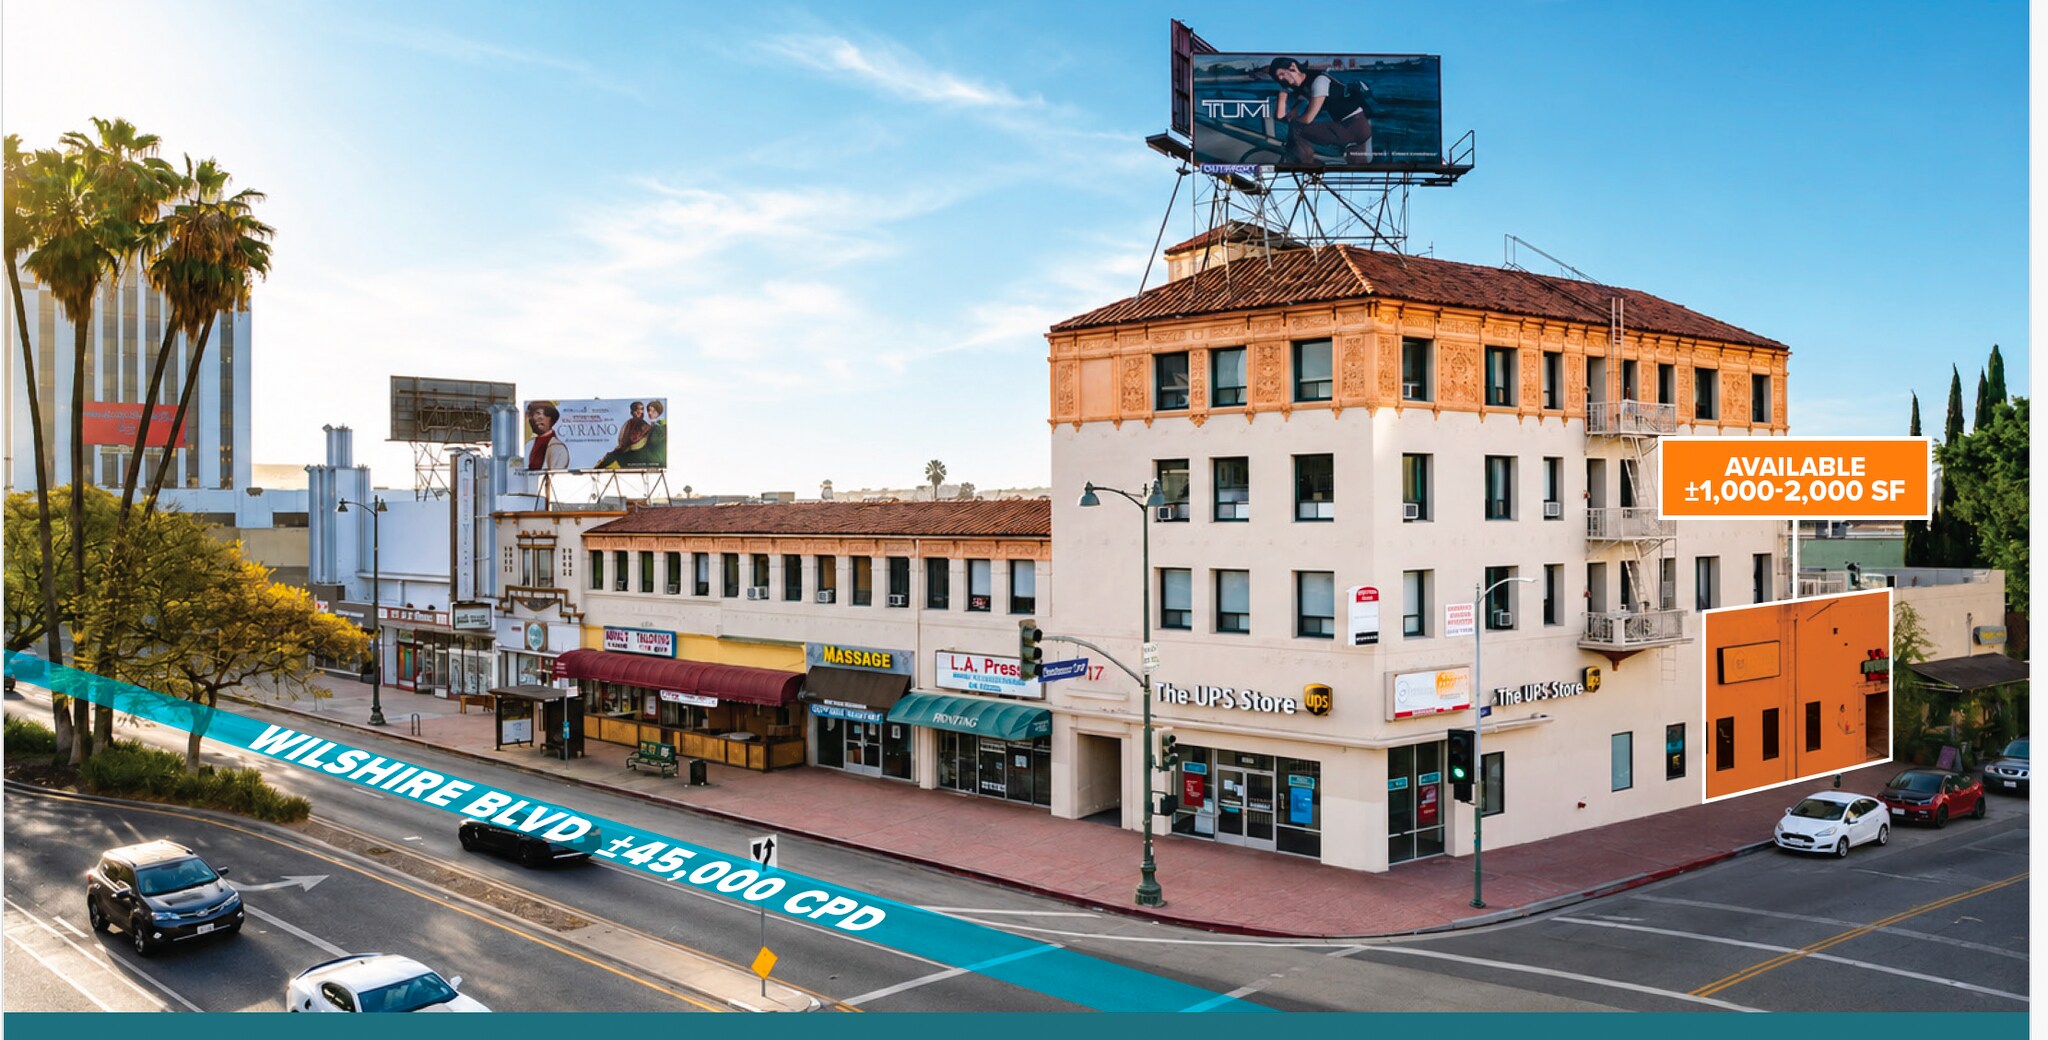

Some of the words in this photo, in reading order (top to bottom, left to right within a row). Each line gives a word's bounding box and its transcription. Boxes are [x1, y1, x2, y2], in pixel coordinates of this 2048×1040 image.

[1202, 97, 1270, 118] TUMI
[557, 423, 618, 437] CYRANO
[823, 645, 892, 669] MASSAGE
[951, 655, 978, 673] L.A.
[1155, 682, 1189, 705] The
[1195, 685, 1235, 710] UPS
[1240, 689, 1297, 715] Store
[1306, 693, 1329, 713] ups
[1497, 688, 1522, 706] The
[1525, 682, 1549, 701] UPS
[1552, 680, 1585, 698] Store
